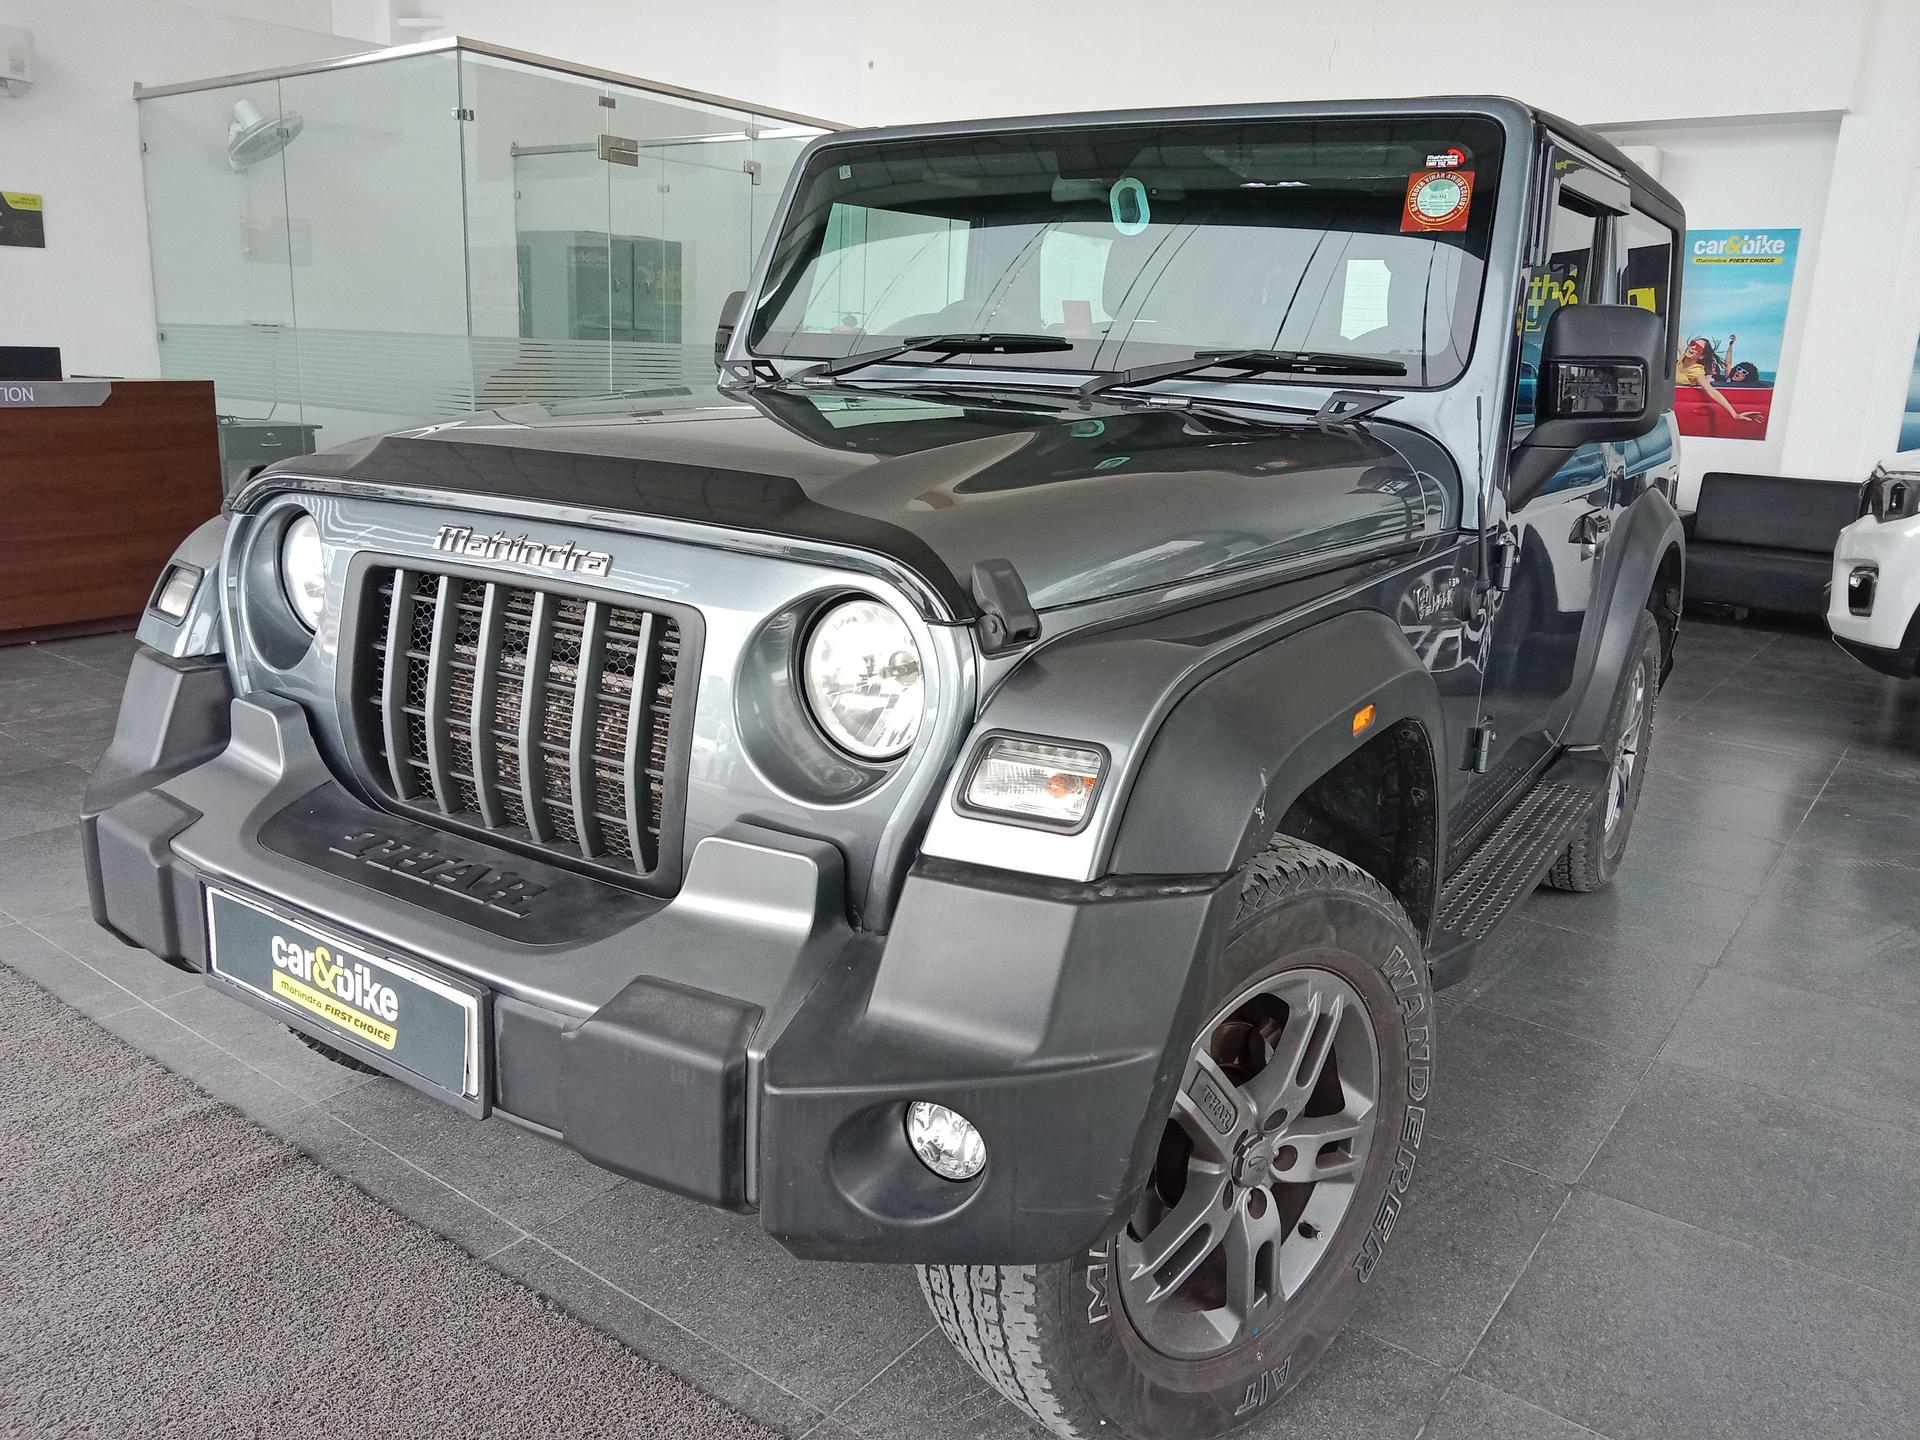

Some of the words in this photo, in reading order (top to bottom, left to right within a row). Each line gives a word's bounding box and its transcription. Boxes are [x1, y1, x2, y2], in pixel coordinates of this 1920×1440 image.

[1694, 235, 1785, 255] car&bike
[432, 522, 614, 577] Mahindra
[271, 935, 399, 1022] car&bike
[324, 1003, 354, 1024] FIRST
[353, 1017, 391, 1043] CHOICE
[1352, 945, 1432, 1283] WANDERER
